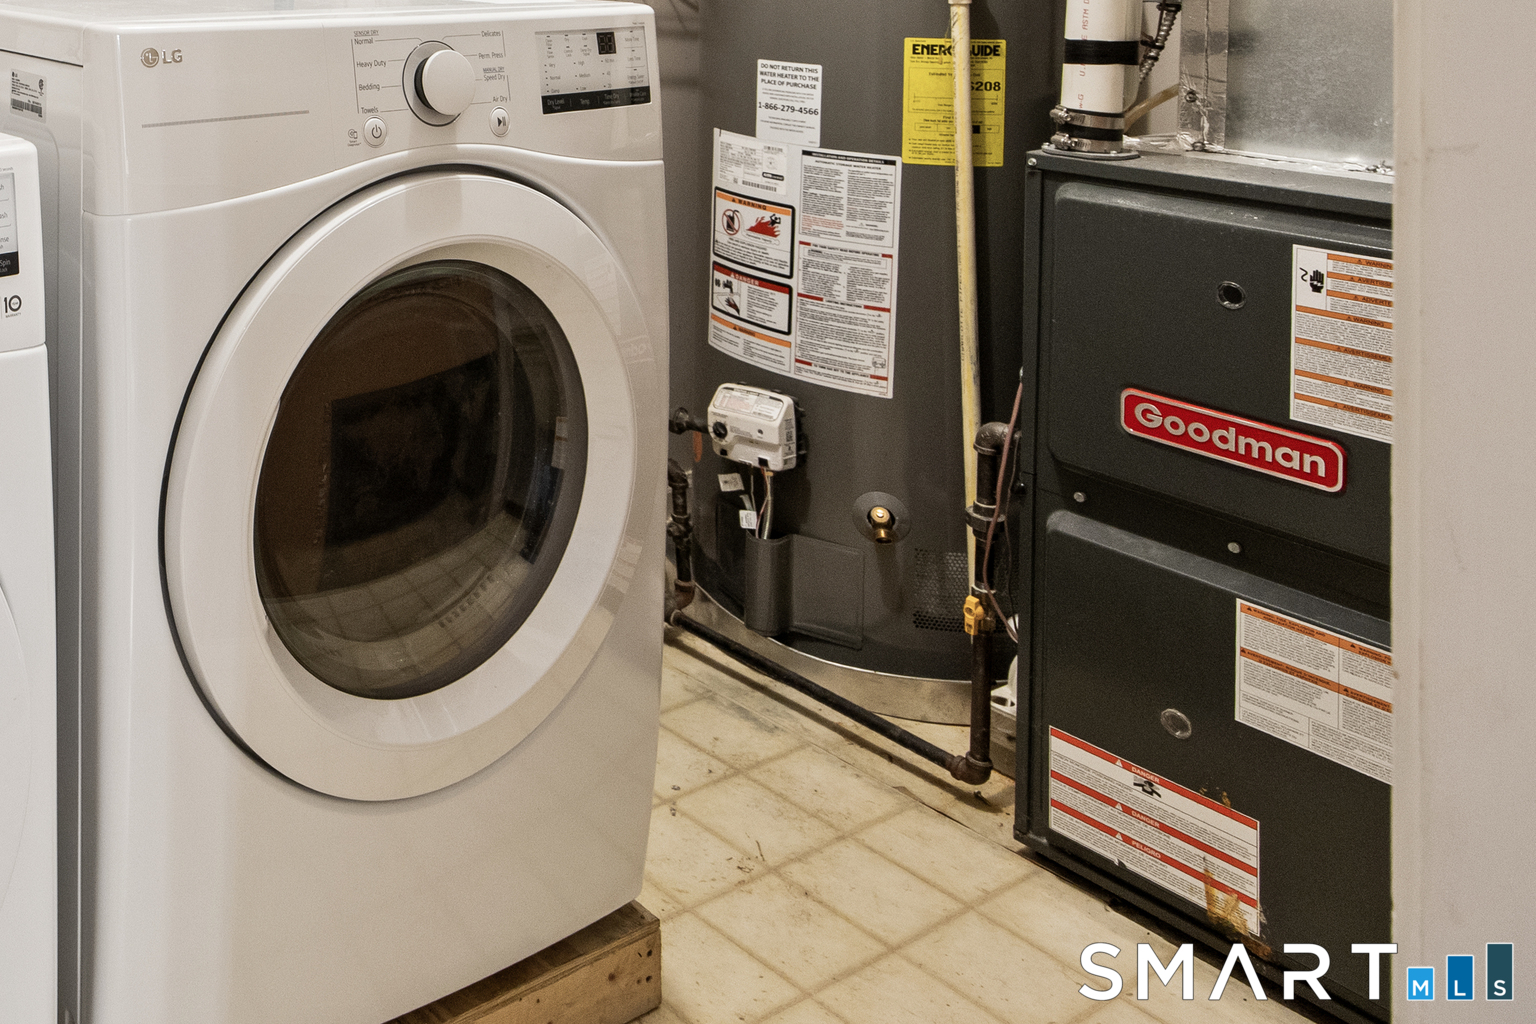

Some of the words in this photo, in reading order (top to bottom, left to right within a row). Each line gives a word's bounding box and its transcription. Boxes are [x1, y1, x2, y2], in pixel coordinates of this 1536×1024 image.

[162, 49, 183, 64] LG
[374, 60, 387, 68] Duty
[781, 65, 804, 73] RETURN
[777, 72, 798, 80] HEATER
[359, 83, 381, 91] Bedding
[786, 81, 817, 90] PURCHASE
[758, 101, 819, 116] 1-866-279-4566
[738, 199, 767, 211] WARNING
[736, 273, 759, 286] DANGER
[4, 294, 22, 314] 10
[1354, 318, 1384, 327] WARNING
[1354, 383, 1384, 393] WARNING
[1134, 402, 1326, 477] Goodman
[1131, 767, 1160, 784] DANGER
[1131, 811, 1160, 828] DANGER
[1131, 840, 1162, 859] PELIGRO
